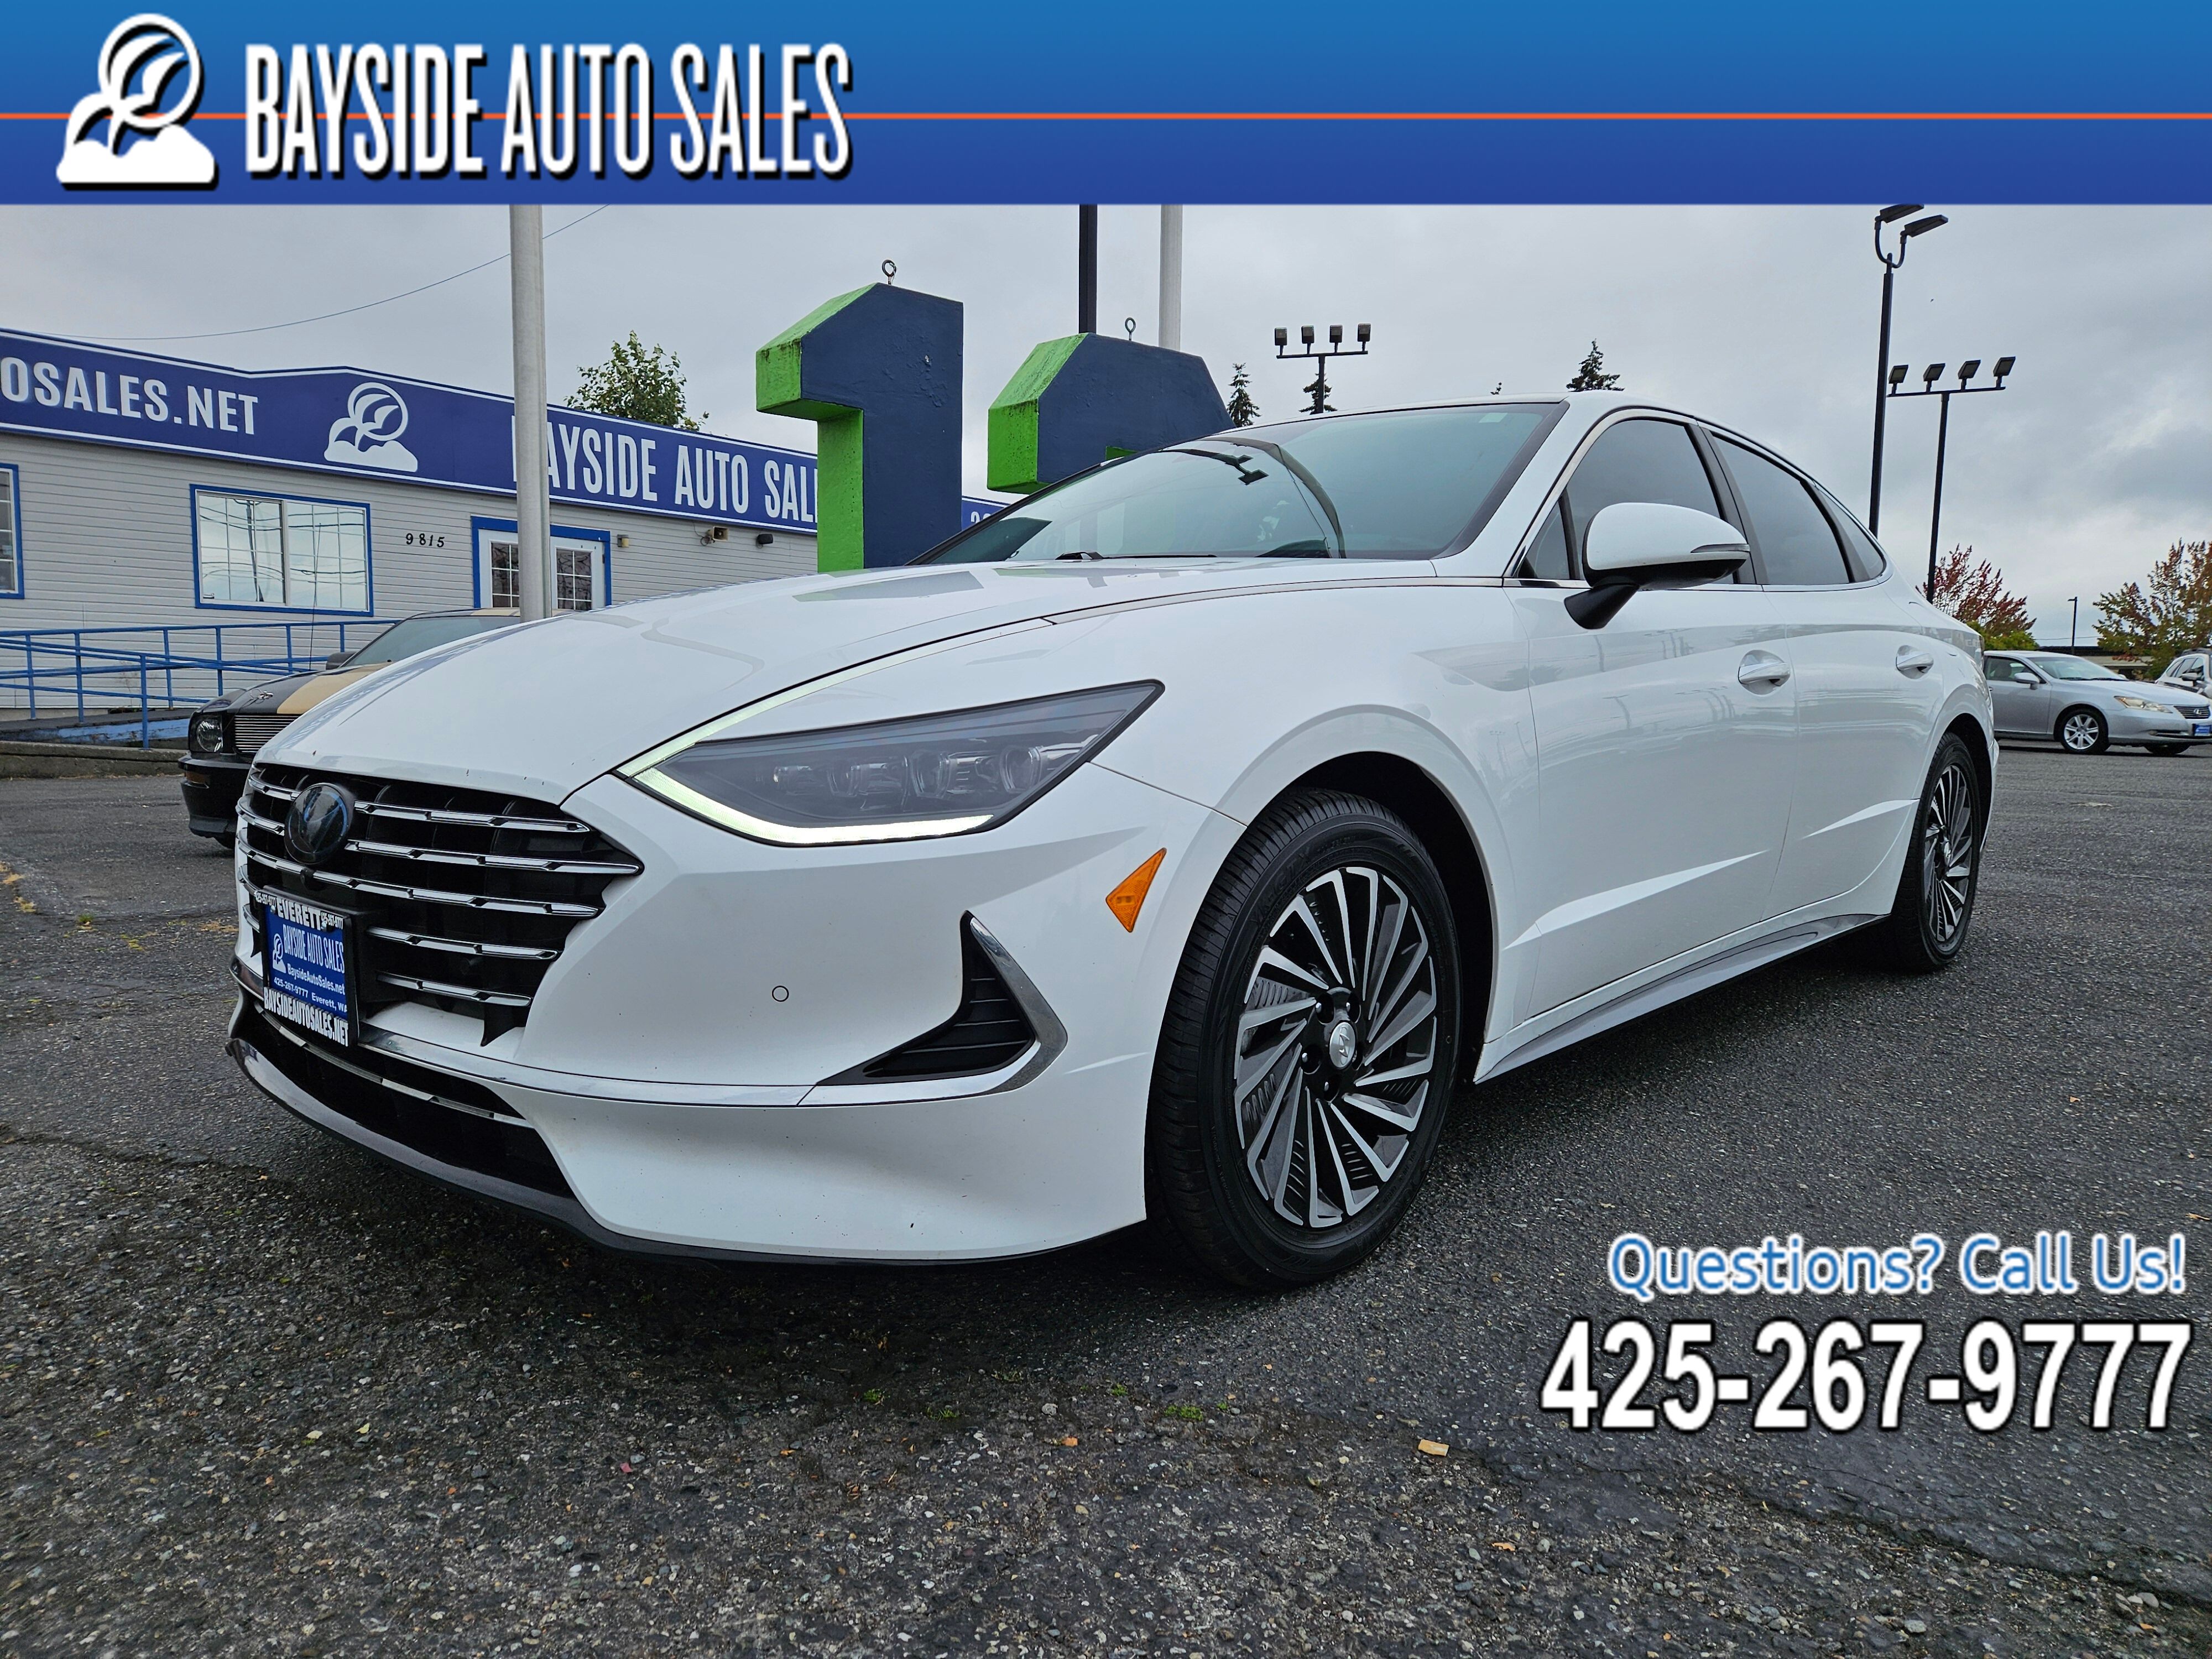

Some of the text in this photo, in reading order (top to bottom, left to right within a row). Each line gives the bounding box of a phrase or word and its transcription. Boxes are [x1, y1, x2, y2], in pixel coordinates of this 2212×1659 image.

[0, 357, 258, 435] OSALES.NET
[512, 415, 817, 523] AYSIDE AUTO SAL
[406, 533, 445, 547] 9815
[276, 898, 321, 931] EVERETT
[283, 924, 345, 974] BAYSIDE AUTO SALES
[273, 977, 309, 998] 425-267-9777
[311, 992, 337, 1013] Everett,
[287, 963, 346, 995] BaysideAutoSales.net
[264, 987, 349, 1047] BAYSIDEAUTOSALES.NET
